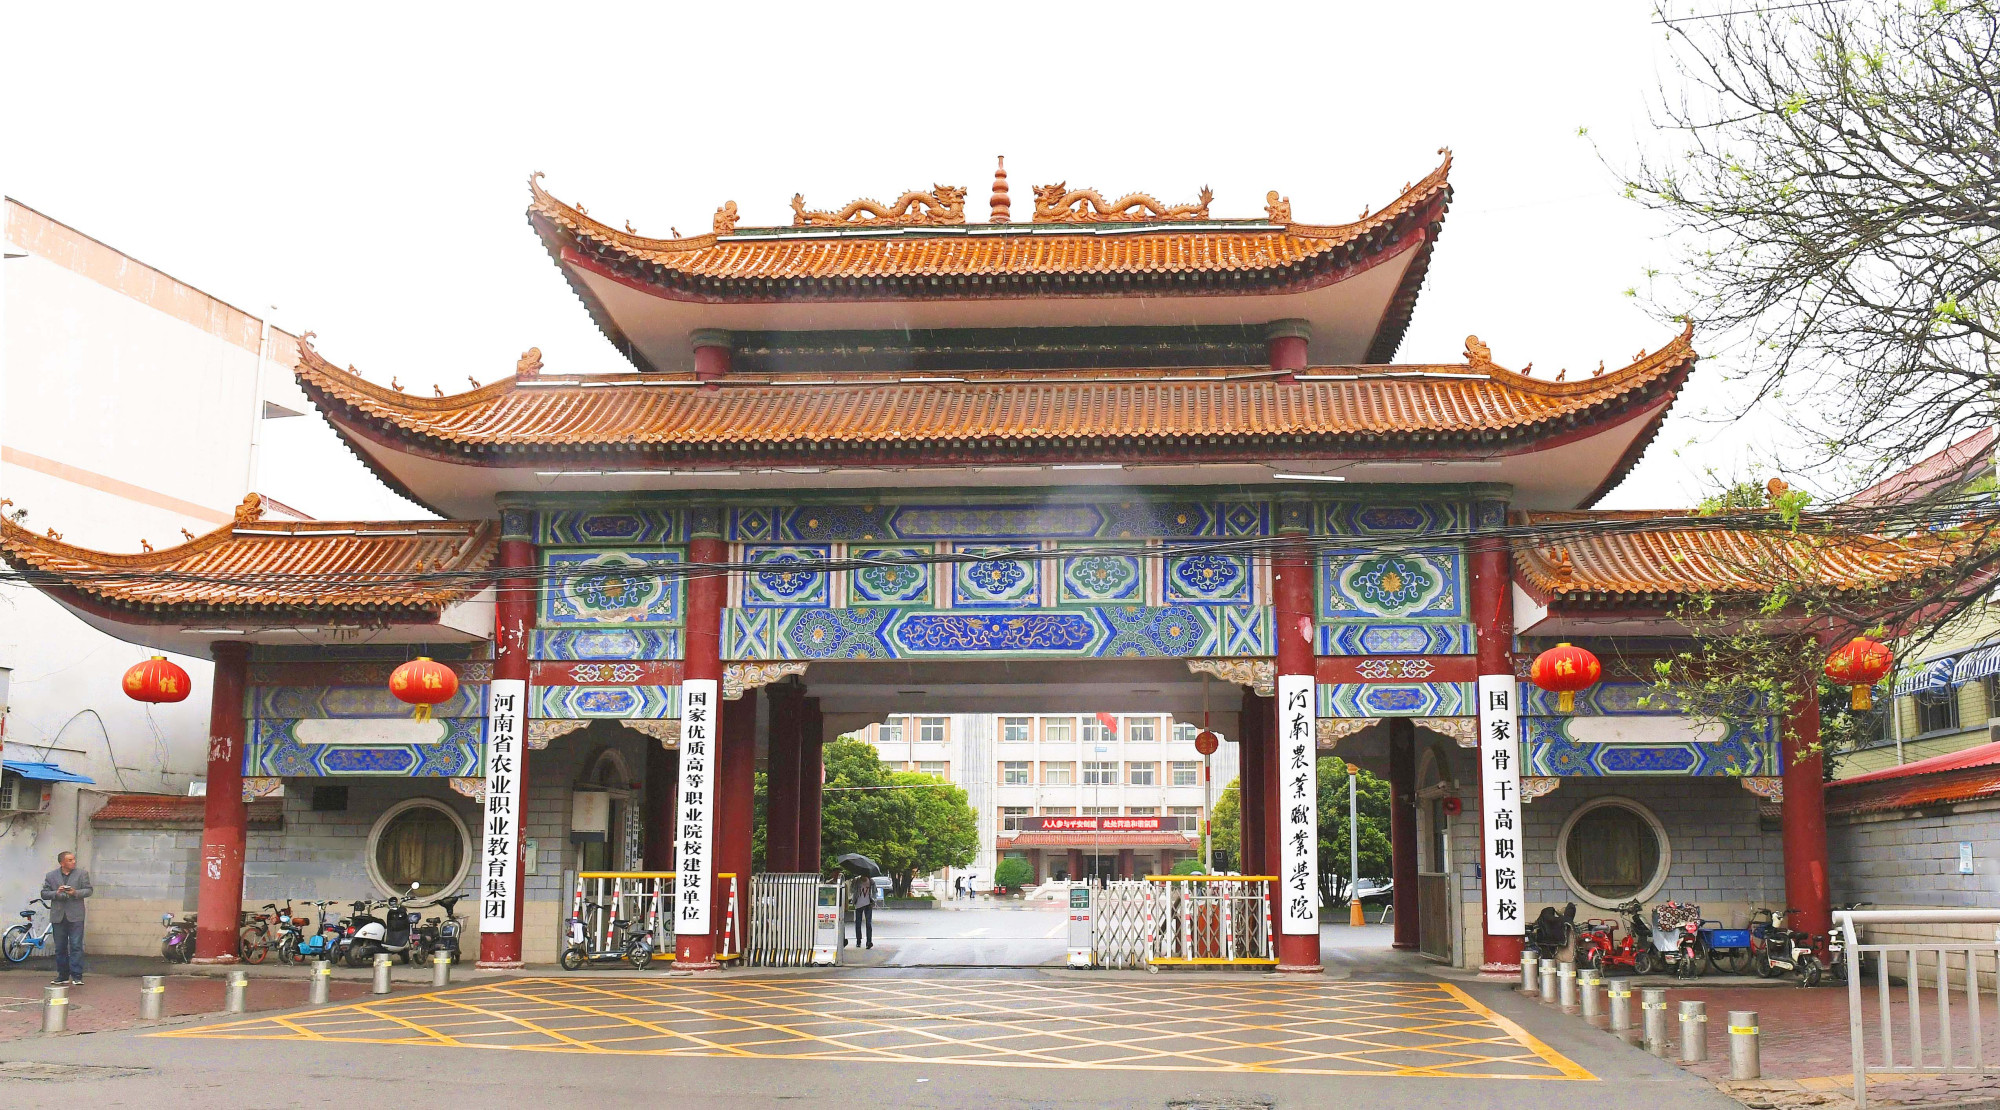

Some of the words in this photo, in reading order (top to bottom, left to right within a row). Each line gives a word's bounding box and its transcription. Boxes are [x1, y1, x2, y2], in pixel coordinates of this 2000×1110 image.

[484, 693, 516, 919] 河南省农业职业教育集团
[682, 692, 707, 920] 国家优质高等职业院校建设单位
[1489, 690, 1517, 921] 国家骨干高职院校
